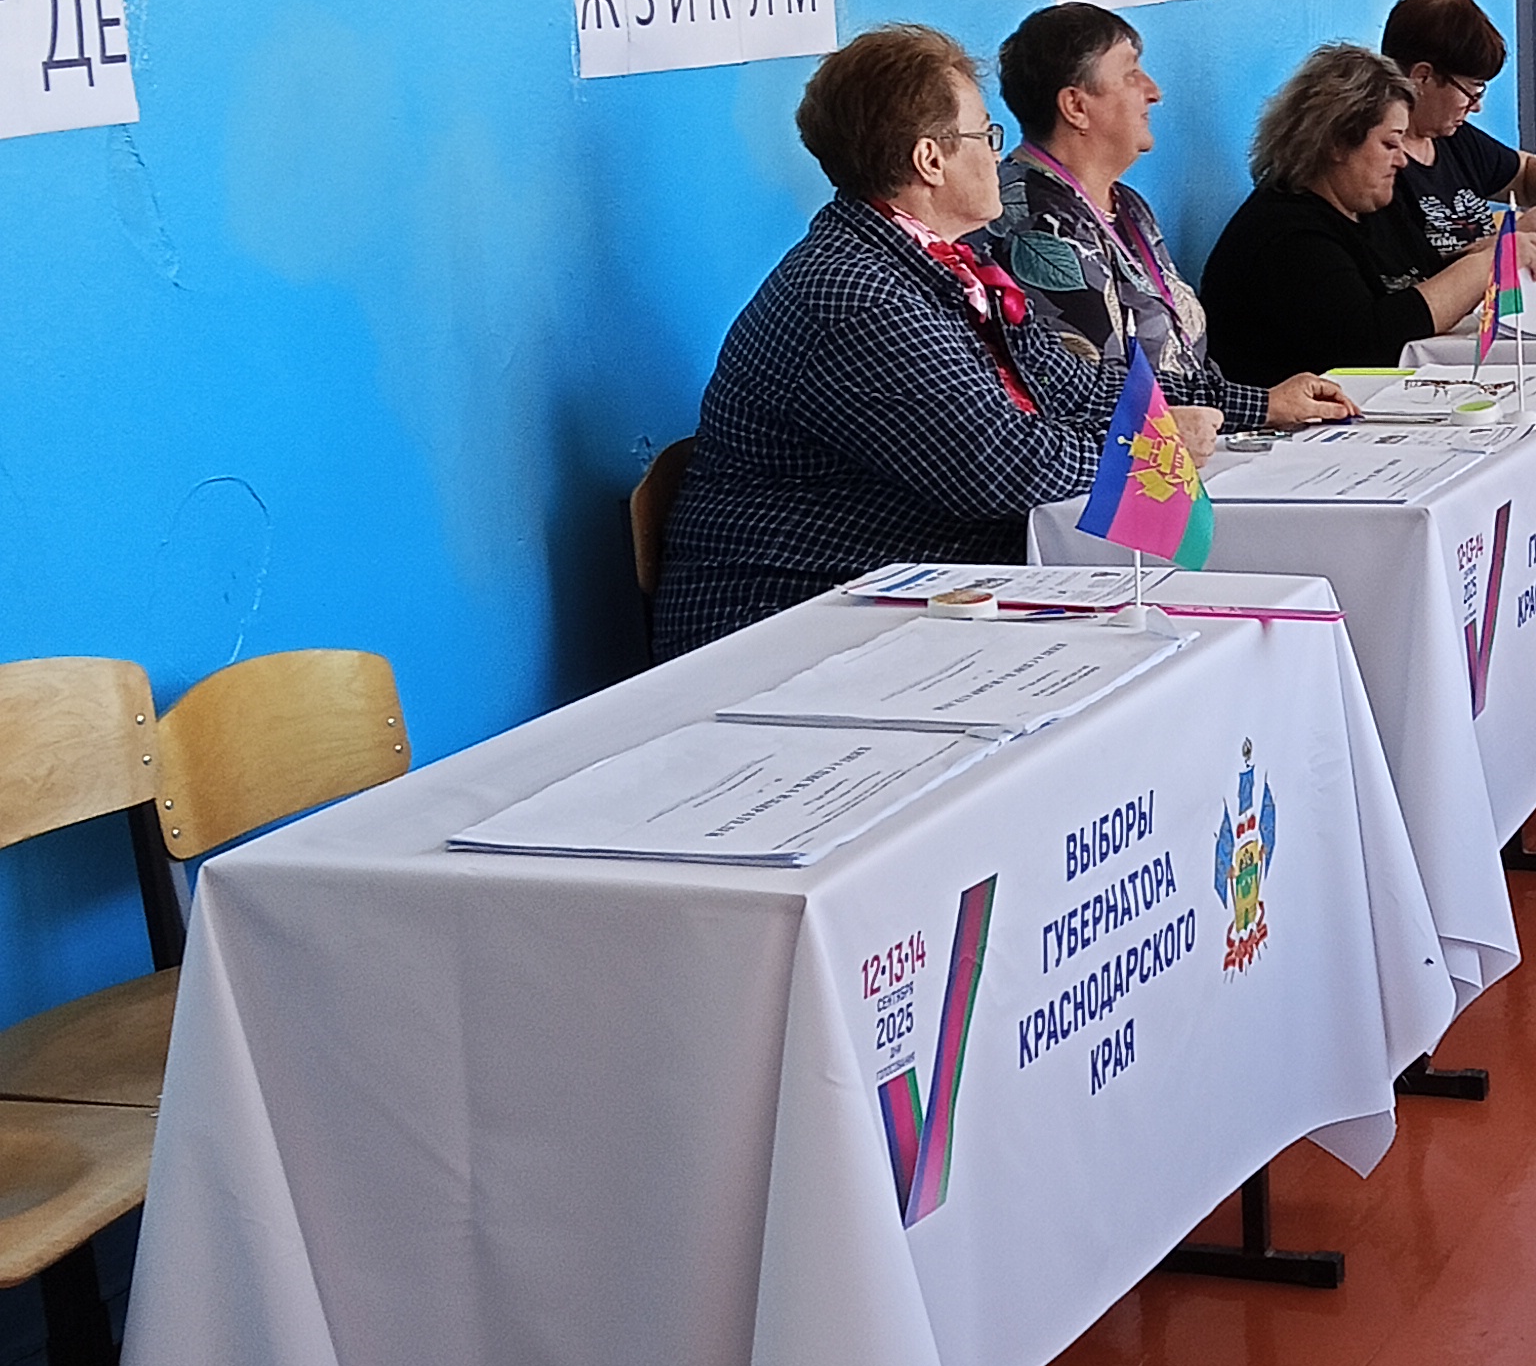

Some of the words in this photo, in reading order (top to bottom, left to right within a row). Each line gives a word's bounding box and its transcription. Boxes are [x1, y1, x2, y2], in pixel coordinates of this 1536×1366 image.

[1066, 790, 1155, 882] ВЫБОРЫ
[1042, 851, 1177, 974] ГУБЕРНАТОРА
[876, 1002, 914, 1050] 2025
[1019, 908, 1196, 1069] КРАСНОДАРСКОГО
[1090, 1018, 1136, 1096] КРАЯ
